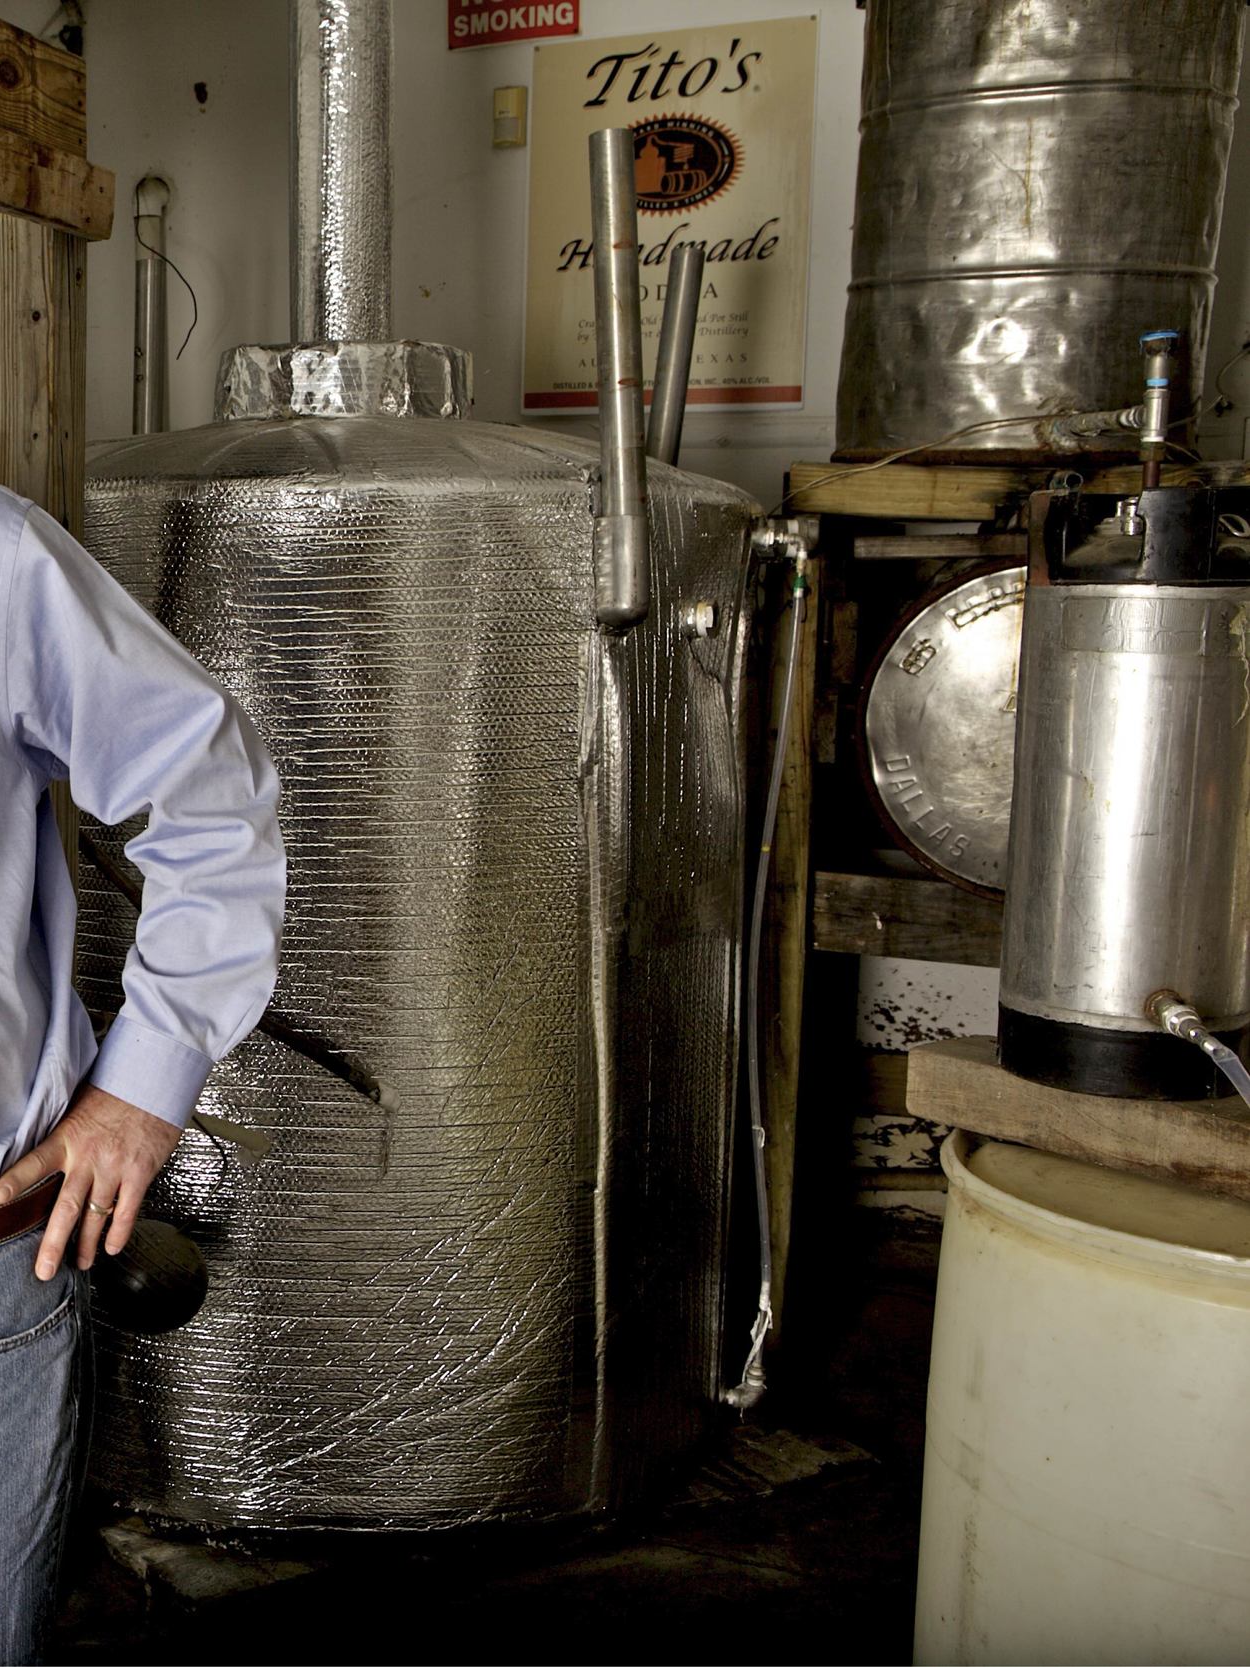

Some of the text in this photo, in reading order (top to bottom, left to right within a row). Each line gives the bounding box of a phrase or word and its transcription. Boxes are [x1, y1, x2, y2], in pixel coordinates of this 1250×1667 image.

[453, 2, 574, 37] SMOKING
[583, 38, 762, 109] Tito's
[696, 352, 748, 363] EXAS
[885, 755, 971, 858] DALLAS
